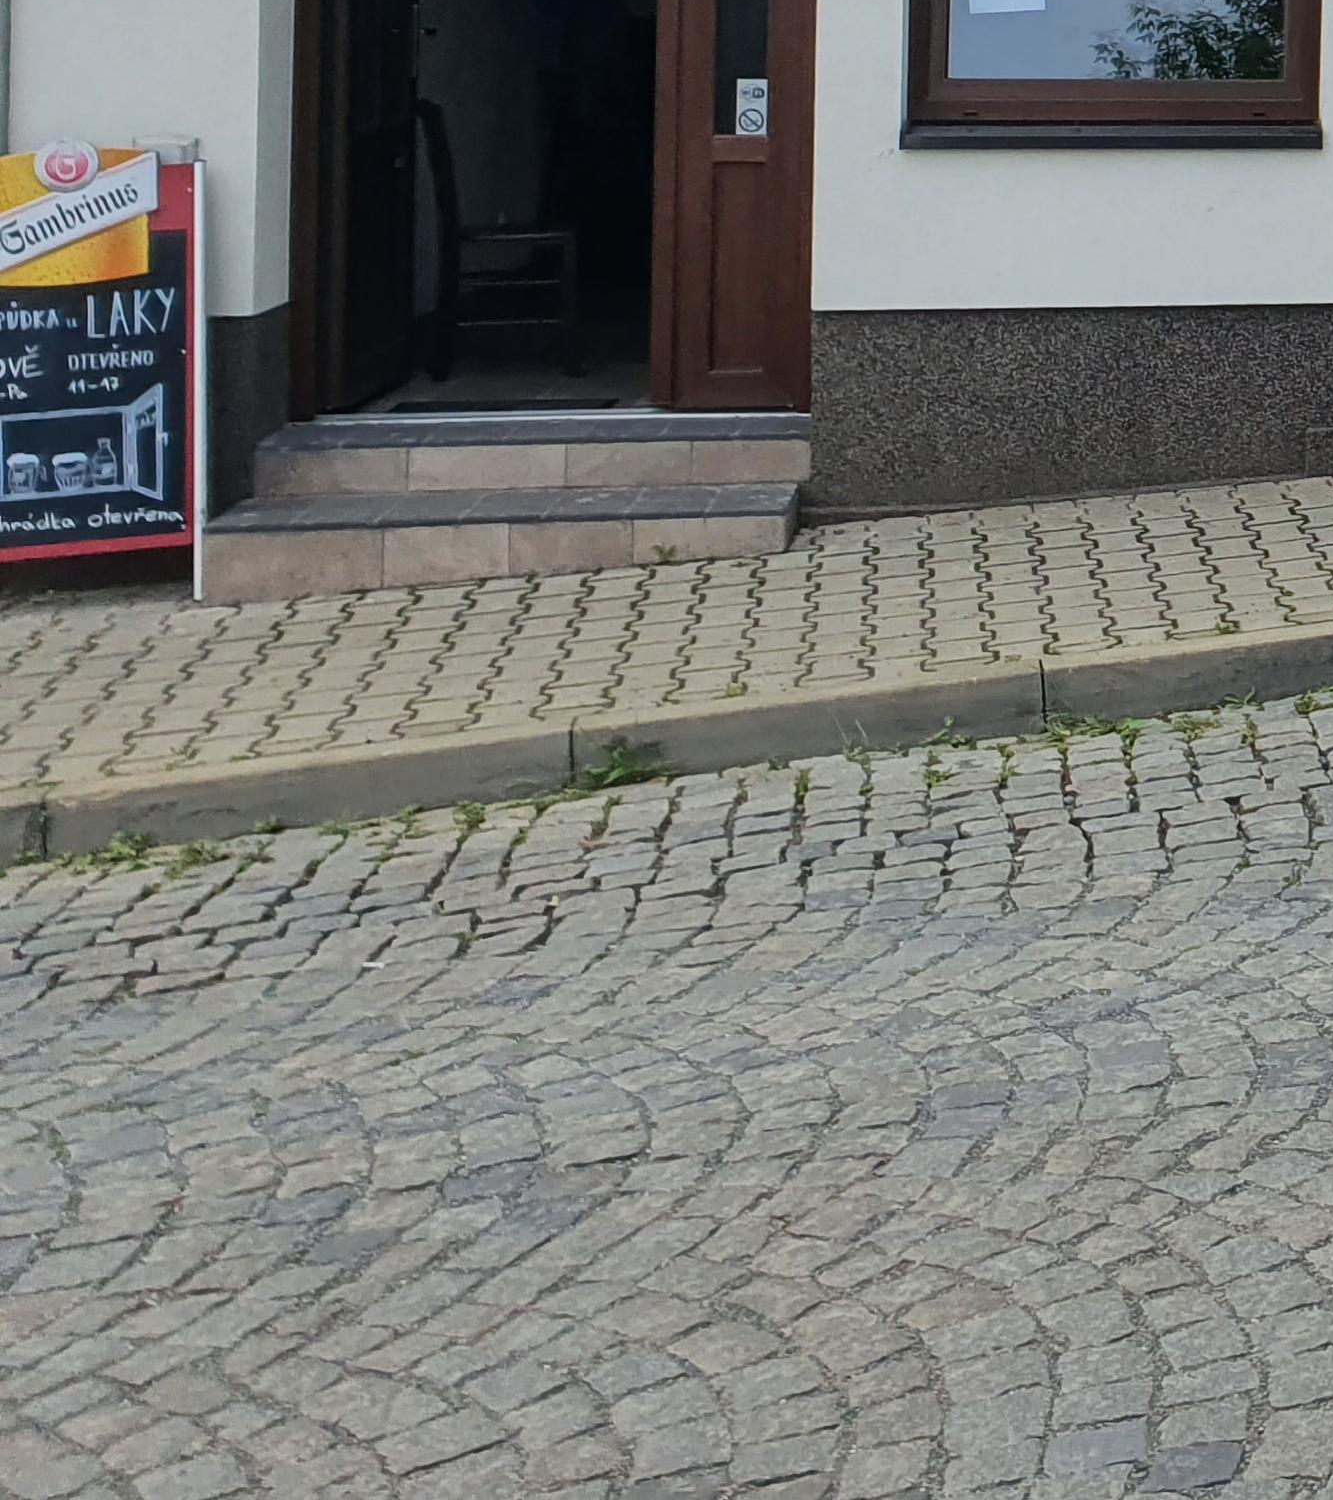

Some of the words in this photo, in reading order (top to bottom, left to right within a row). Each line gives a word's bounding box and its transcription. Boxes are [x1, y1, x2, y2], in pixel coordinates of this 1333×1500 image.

[0, 182, 139, 256] Gambrinus
[86, 286, 176, 339] LAKY
[67, 342, 155, 372] OTEVŘENO
